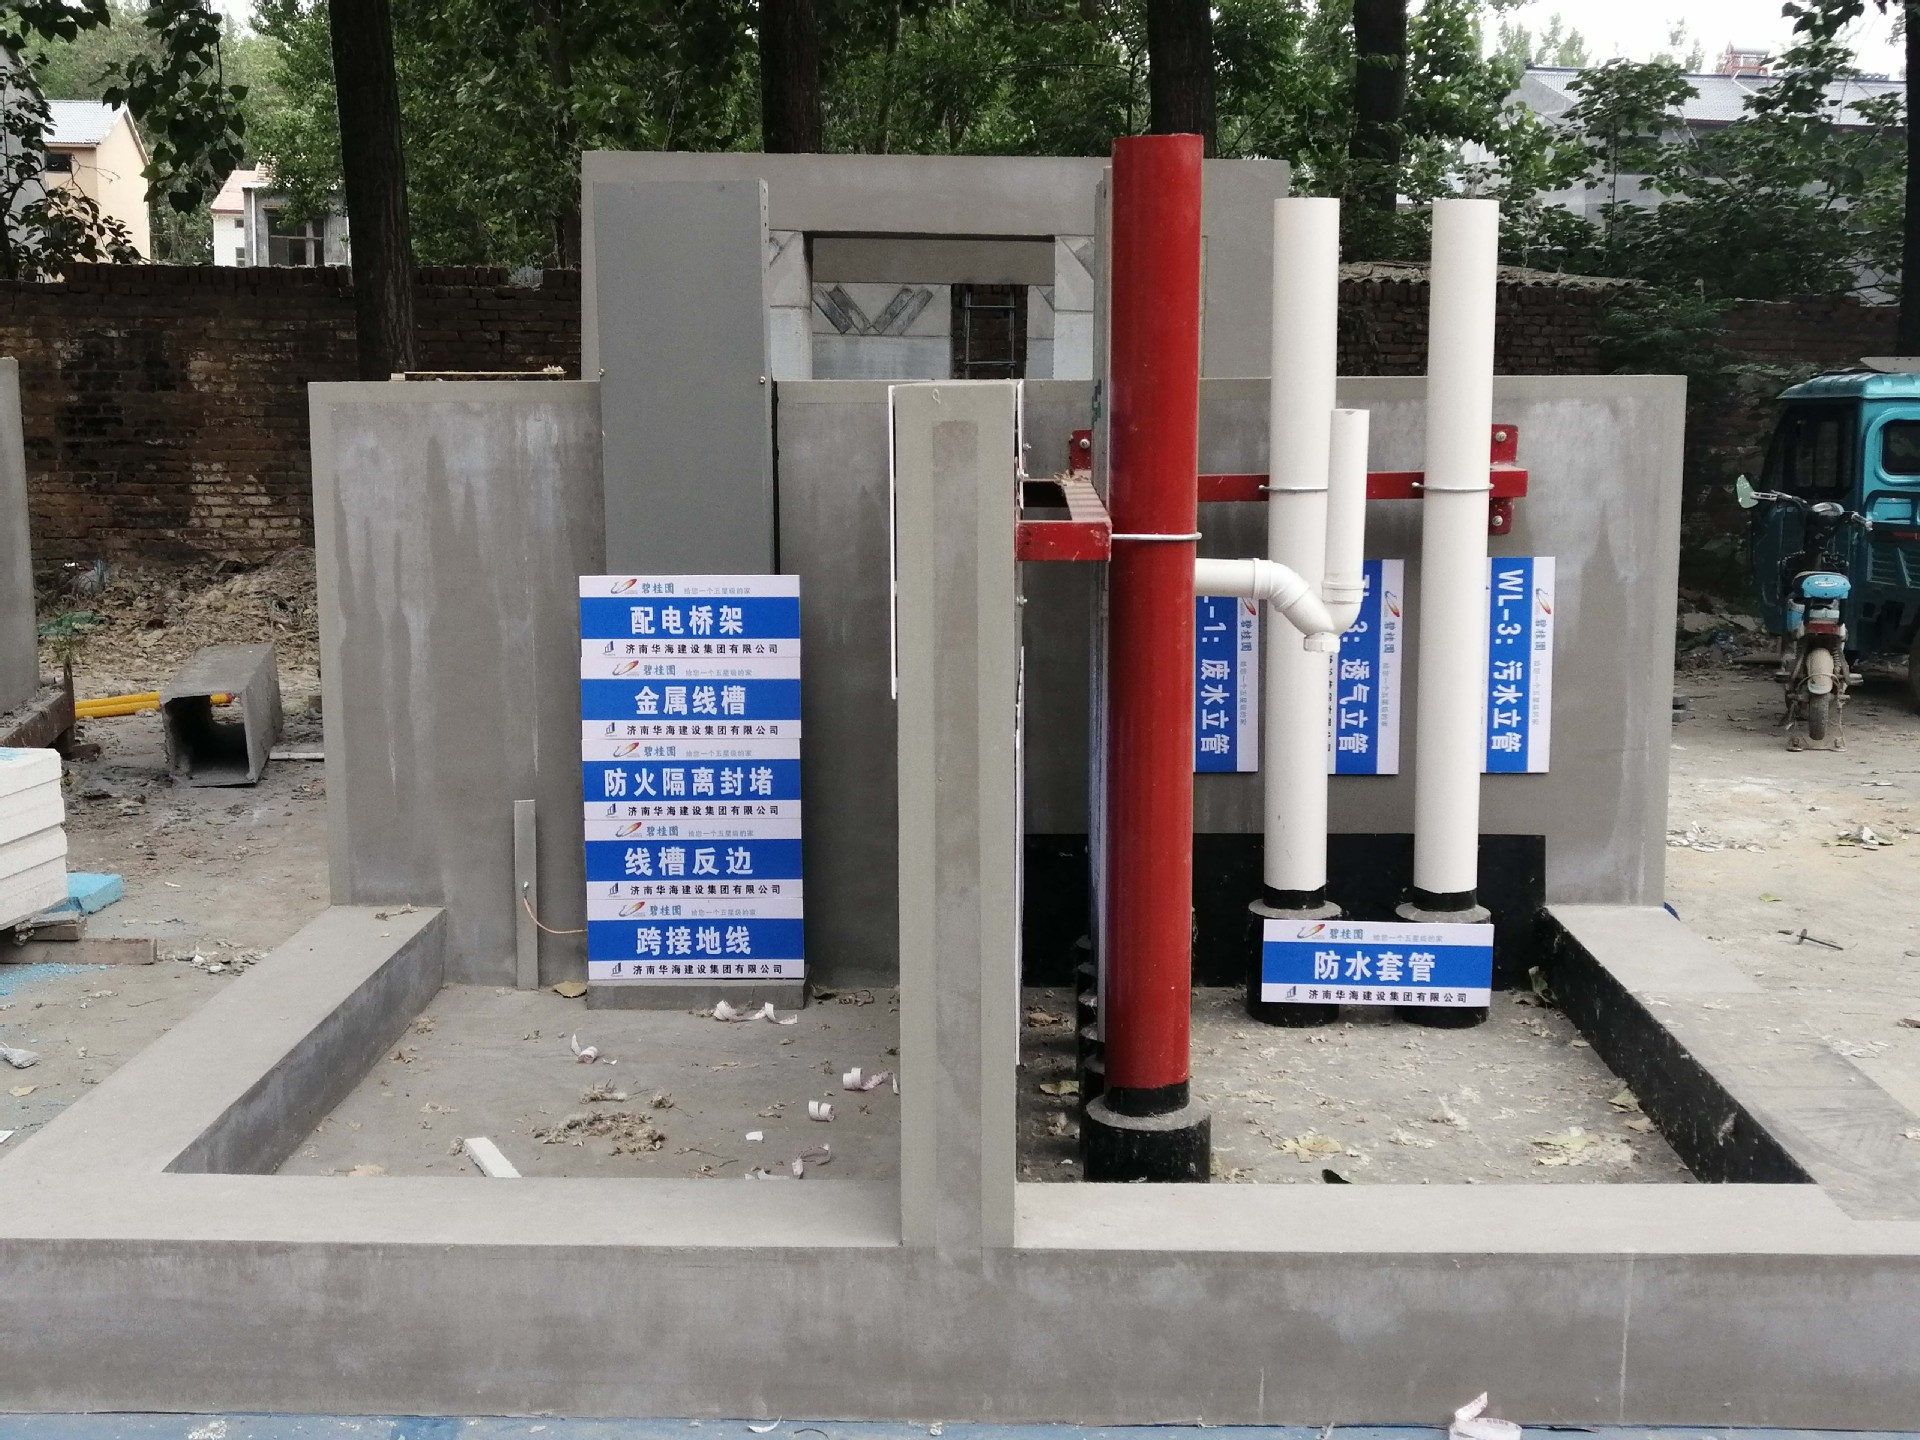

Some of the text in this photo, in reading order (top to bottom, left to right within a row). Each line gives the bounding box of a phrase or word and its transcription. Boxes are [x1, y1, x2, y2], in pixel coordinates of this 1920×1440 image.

[630, 604, 744, 636] 配电桥架
[625, 643, 779, 655] 济南华海建设集团有限公司
[634, 685, 746, 715] 金属线槽
[1200, 658, 1231, 754] 废水立管
[1338, 658, 1370, 754] 透气立管
[1490, 659, 1524, 753] 污水立管
[627, 724, 779, 736] 济南华海建设集团有限公司
[604, 766, 774, 797] 防火隔离封堵
[627, 805, 779, 816] 济南华海建设集团有限公司
[624, 846, 754, 876] 线槽反边
[630, 884, 781, 895] 济南华海建设集团有限公司
[636, 925, 752, 956] 跨接地线
[633, 963, 783, 975] 济南华海建设集团有限公司
[1313, 951, 1436, 982] 防水套管
[1308, 989, 1467, 1003] 济南华海建设集团有限公司
